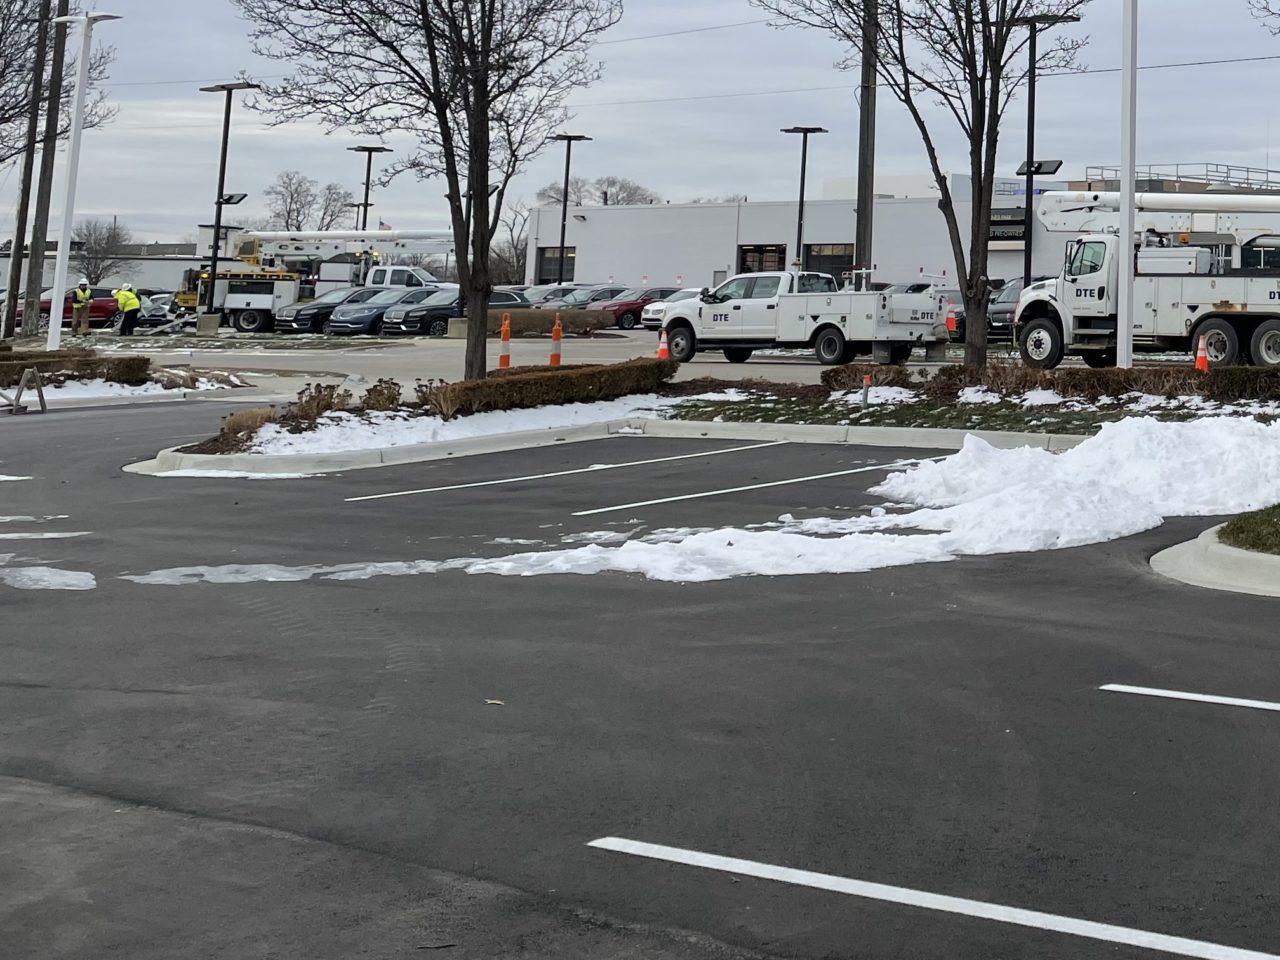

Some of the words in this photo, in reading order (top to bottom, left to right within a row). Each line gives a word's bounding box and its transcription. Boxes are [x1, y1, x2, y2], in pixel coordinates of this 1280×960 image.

[1076, 288, 1096, 297] DTE
[713, 313, 729, 322] DTE
[920, 312, 934, 320] DTE
